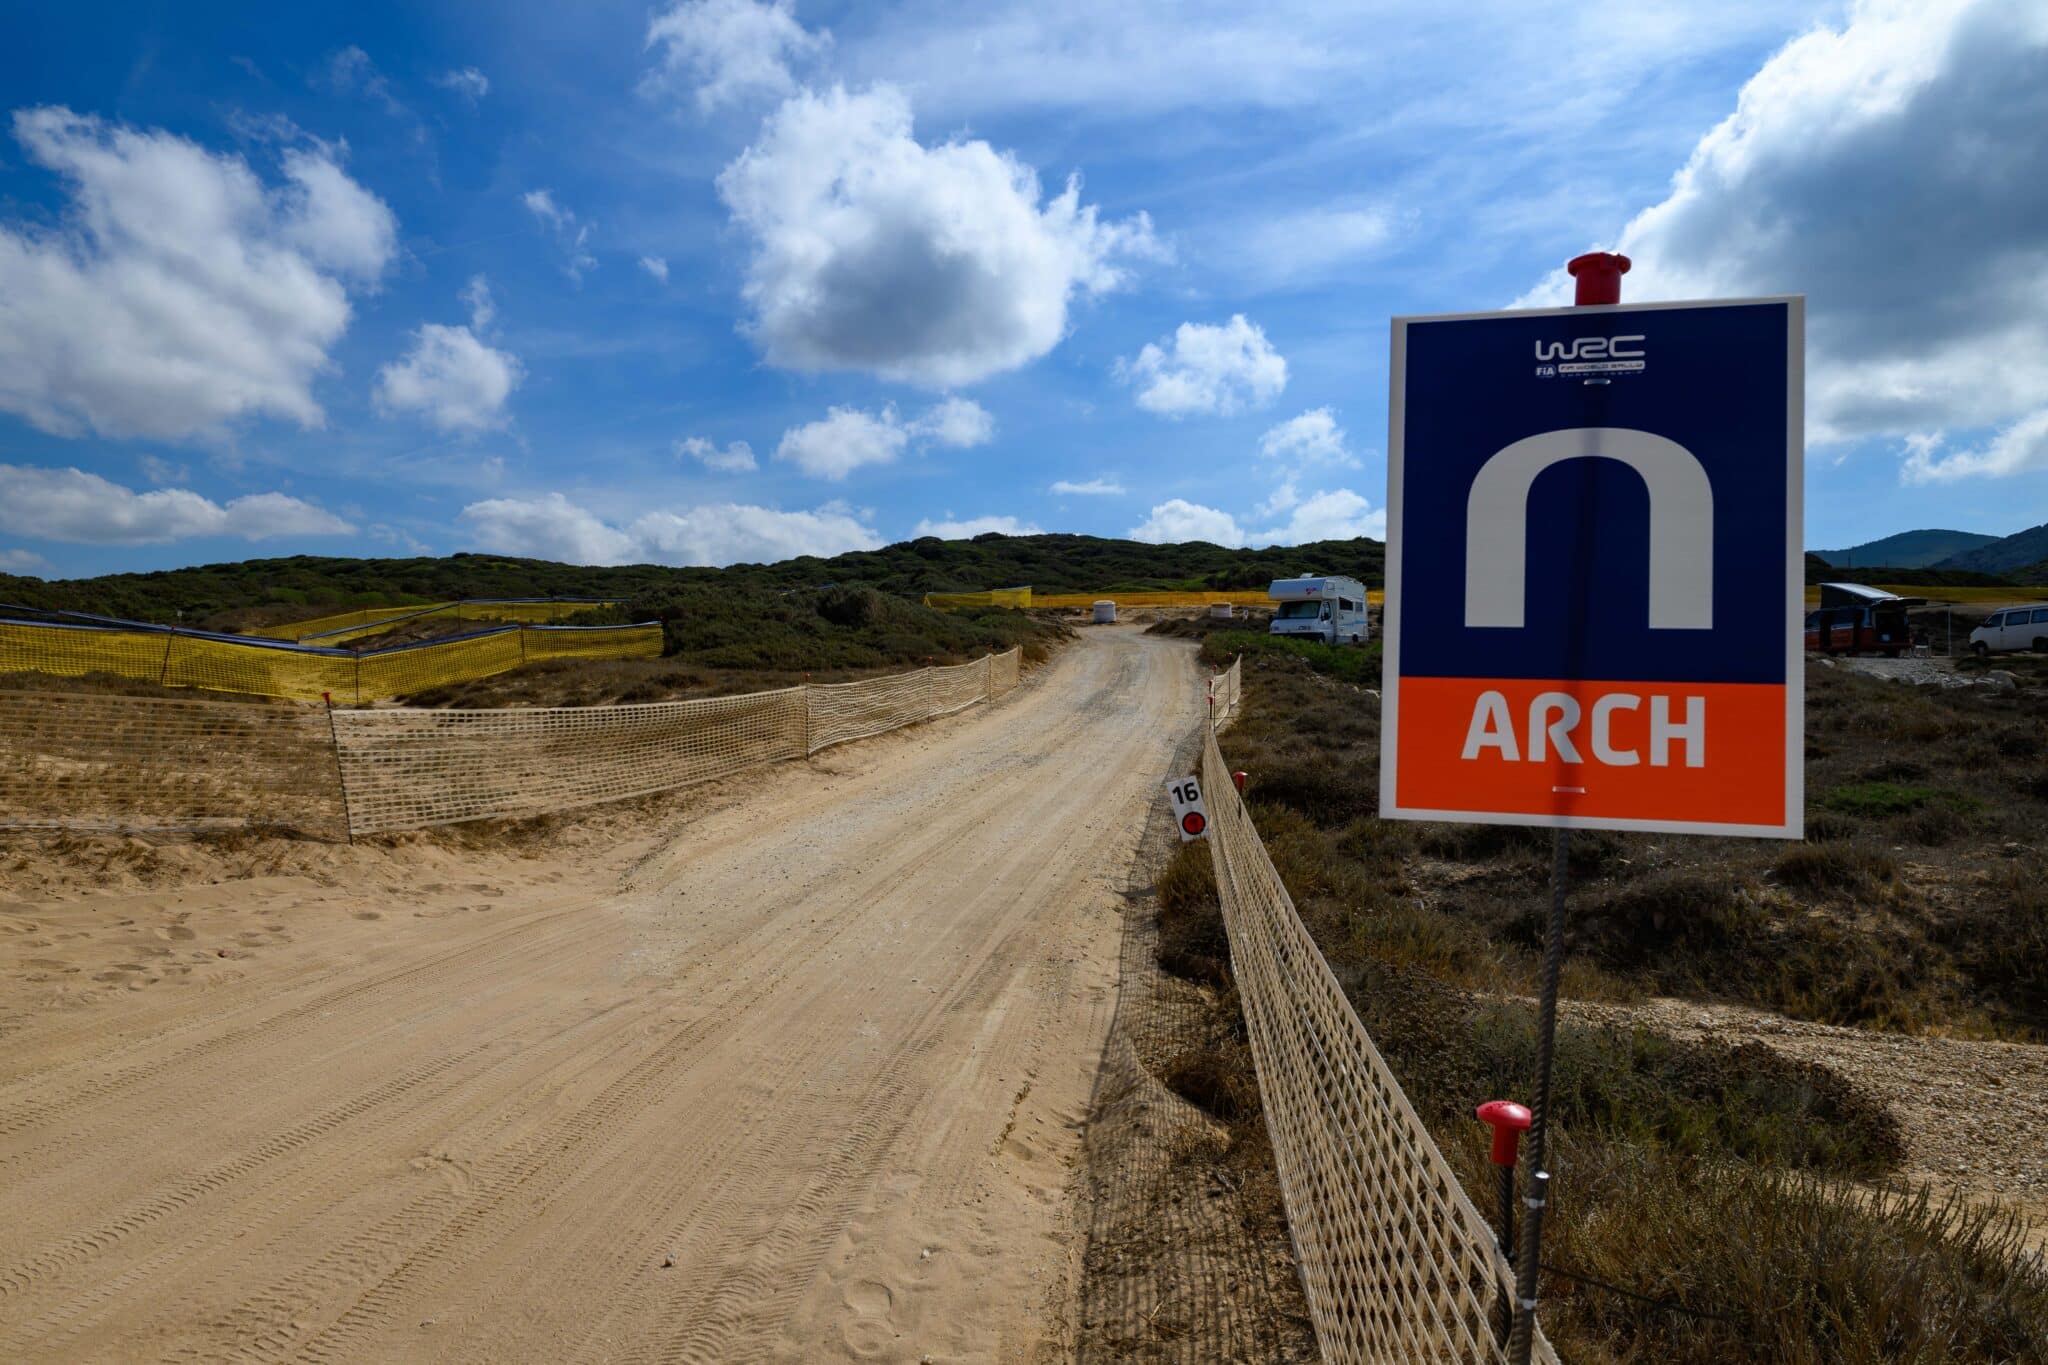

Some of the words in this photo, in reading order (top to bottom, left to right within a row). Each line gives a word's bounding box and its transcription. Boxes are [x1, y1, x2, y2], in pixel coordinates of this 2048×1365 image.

[1535, 335, 1646, 361] WRC
[1461, 690, 1706, 768] ARCH
[1172, 782, 1199, 805] 16
